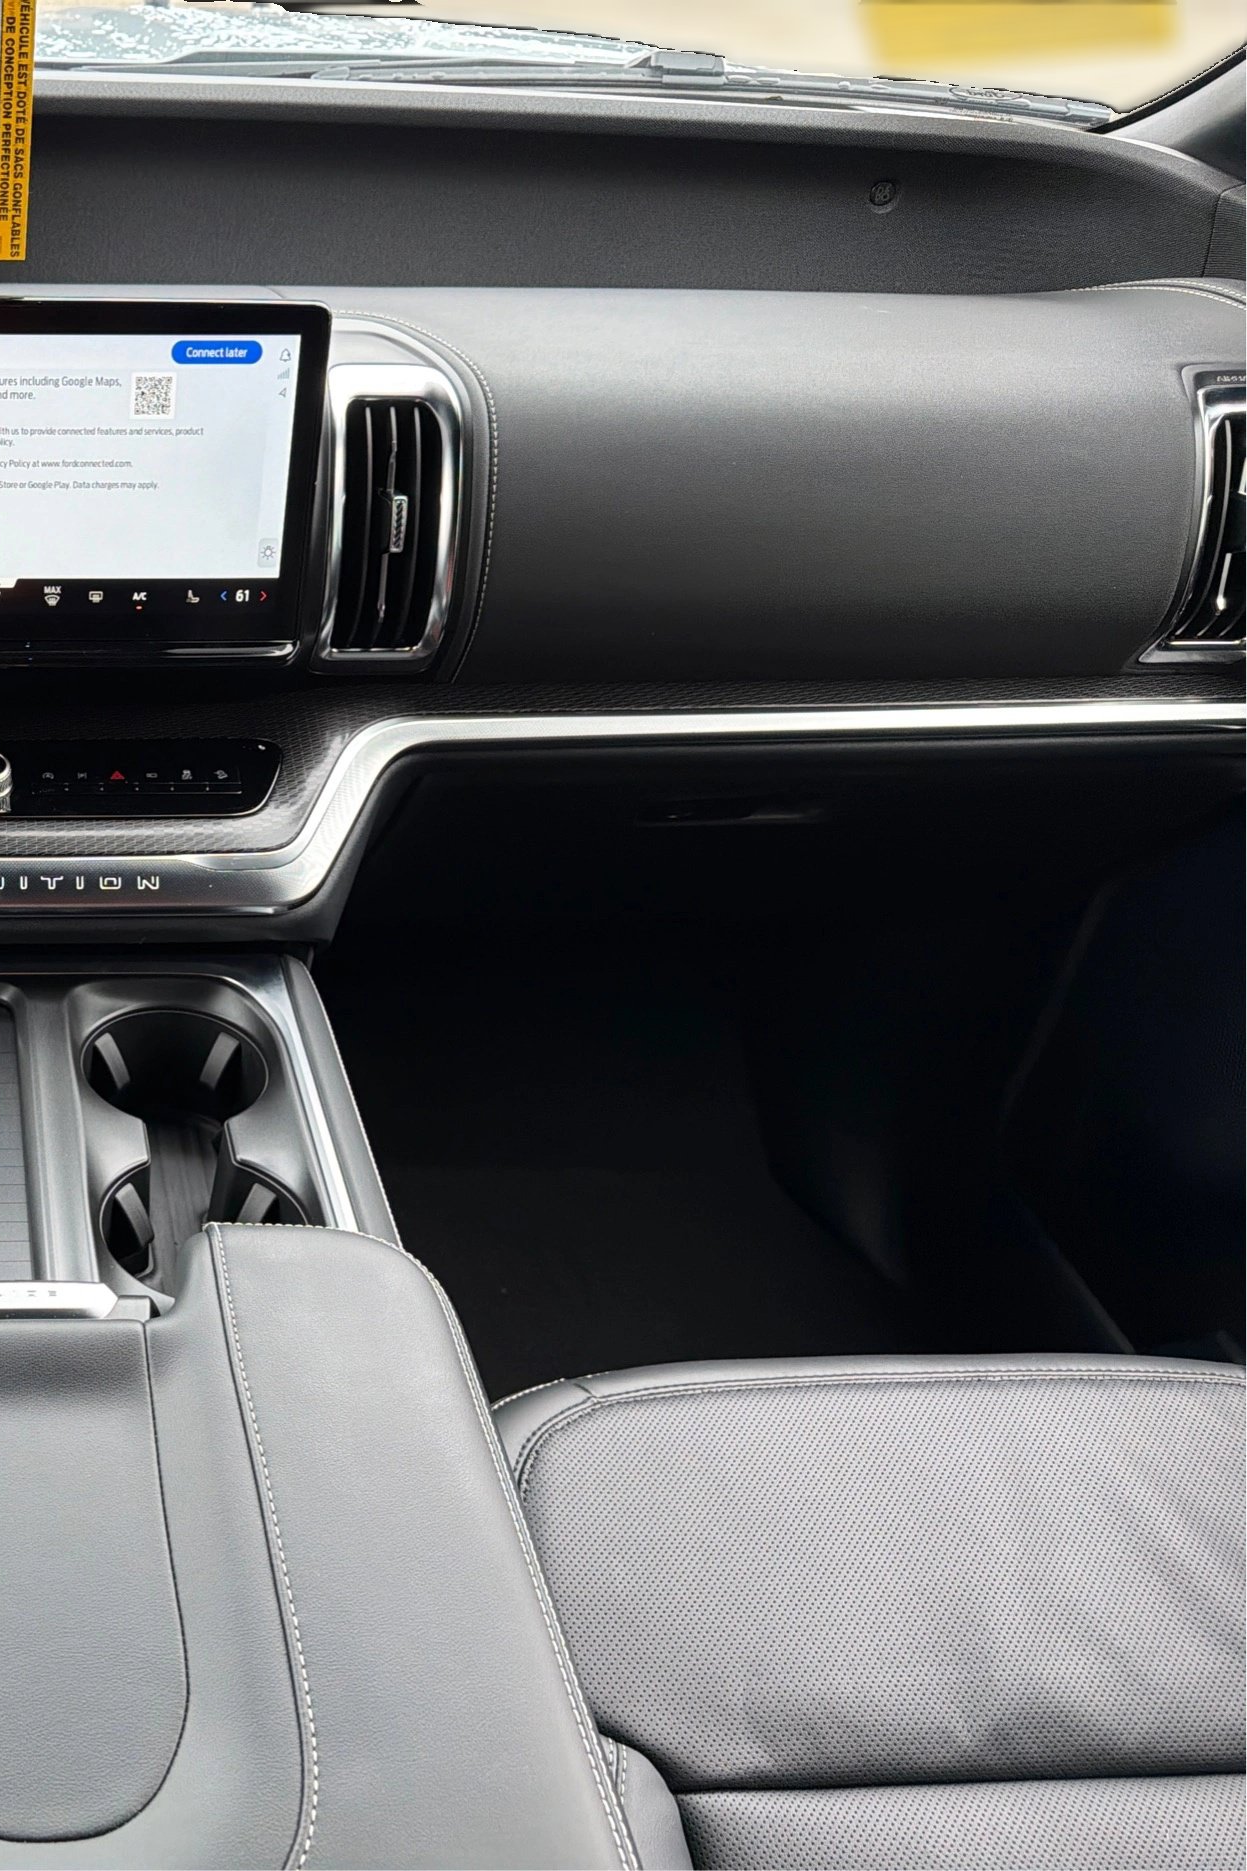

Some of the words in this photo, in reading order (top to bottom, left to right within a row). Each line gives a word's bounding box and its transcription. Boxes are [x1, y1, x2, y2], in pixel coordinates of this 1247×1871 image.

[6, 16, 16, 32] DE
[3, 38, 15, 118] CONCEPTION
[18, 63, 28, 86] EST
[16, 91, 29, 123] DOTÉ
[15, 128, 25, 143] DE
[14, 148, 25, 178] SACS
[0, 123, 12, 219] PERFECTIONNÉE
[11, 183, 23, 256] GONFLABLES
[186, 346, 224, 358] Connect
[225, 346, 247, 358] later
[19, 375, 59, 388] including
[61, 375, 93, 388] Google
[95, 376, 122, 388] Maps,
[9, 391, 35, 399] more.
[20, 427, 29, 435] to
[29, 426, 56, 436] provide
[57, 427, 96, 435] connected
[97, 426, 127, 435] features
[128, 427, 143, 435] and
[143, 426, 174, 436] services,
[174, 426, 204, 437] product
[8, 459, 30, 469] Policy
[31, 459, 39, 467] at
[27, 480, 53, 490] Google
[53, 480, 70, 490] Play.
[72, 480, 90, 489] Data
[91, 480, 119, 490] charges
[120, 482, 136, 490] may
[137, 480, 159, 490] apply.
[44, 586, 62, 594] MAX
[132, 592, 147, 601] A/C
[235, 590, 250, 602] 61
